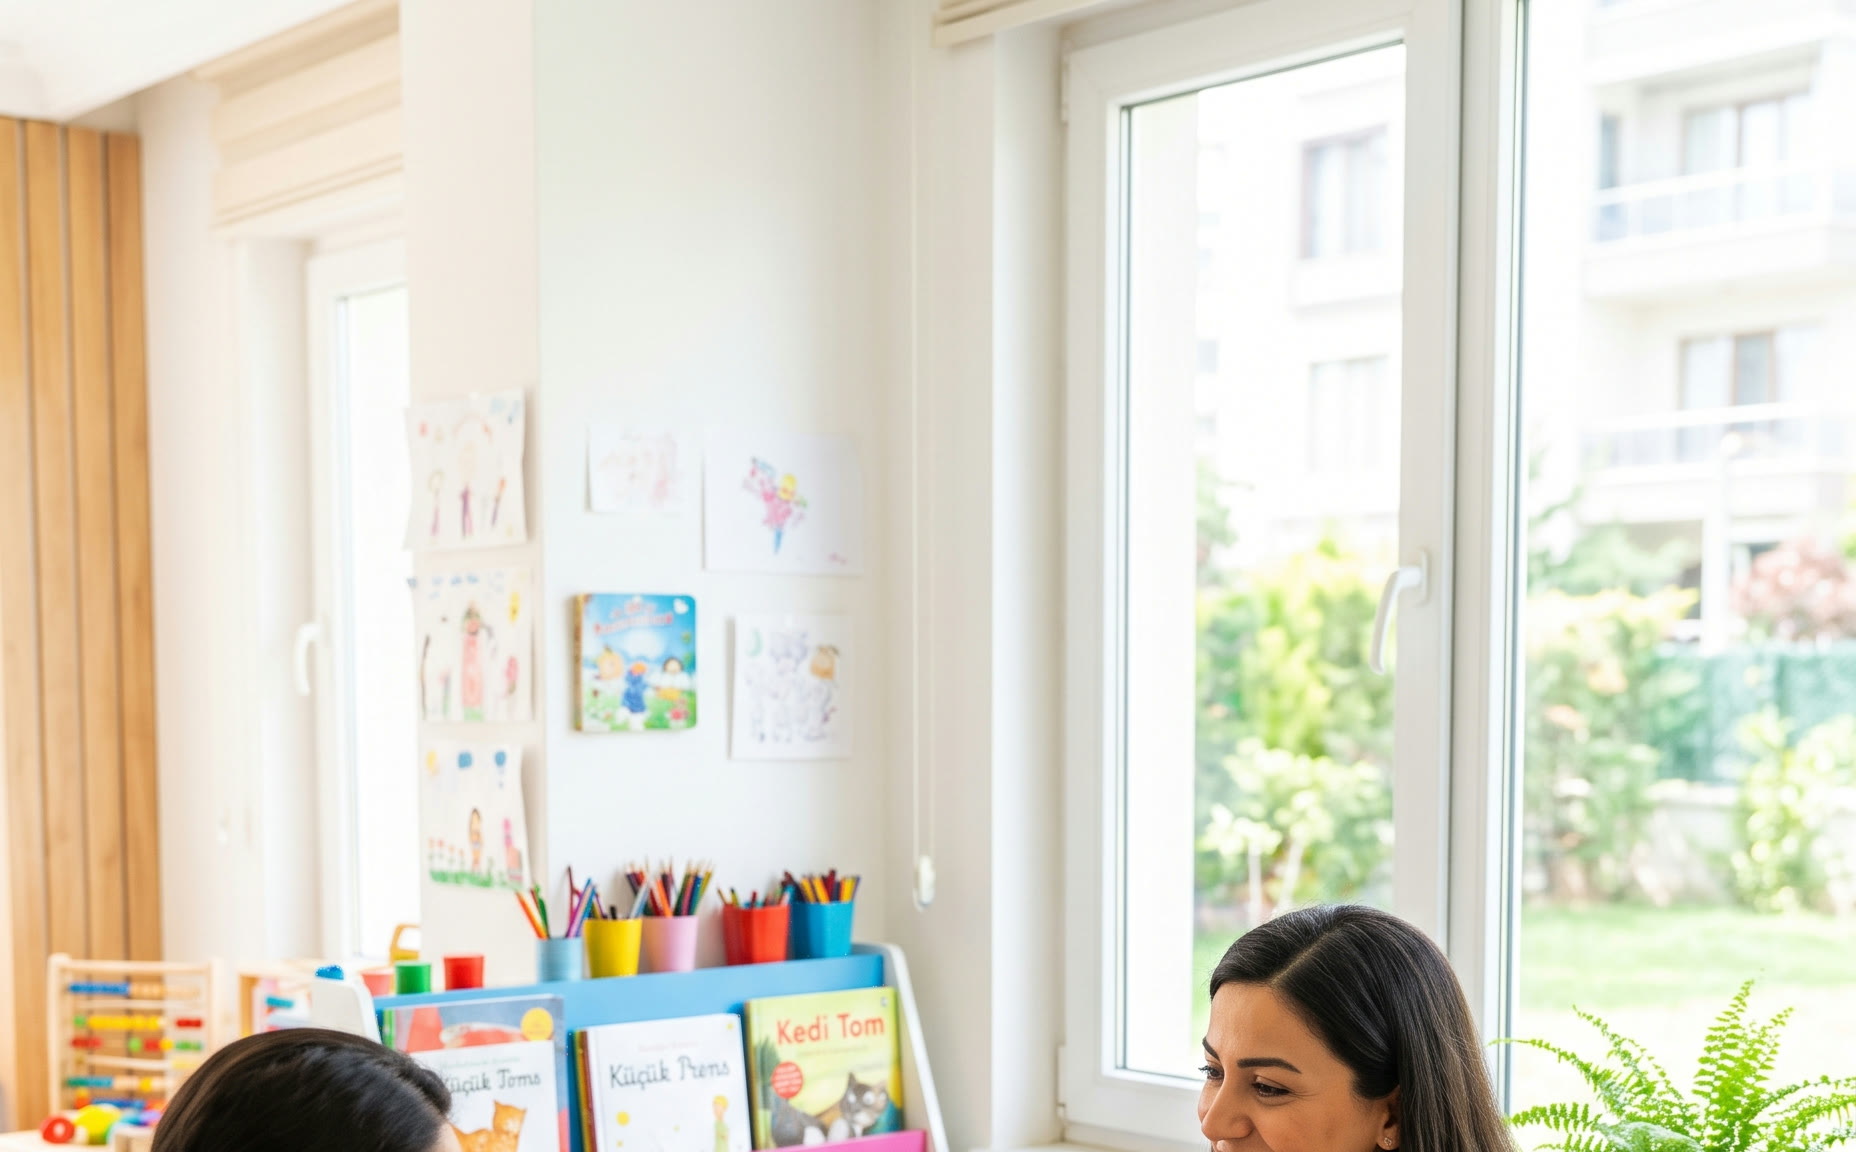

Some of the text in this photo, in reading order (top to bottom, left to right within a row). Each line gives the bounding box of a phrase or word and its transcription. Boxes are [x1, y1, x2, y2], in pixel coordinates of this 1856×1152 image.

[776, 1012, 885, 1045] Kedi Tom
[608, 1058, 671, 1091] Küçük
